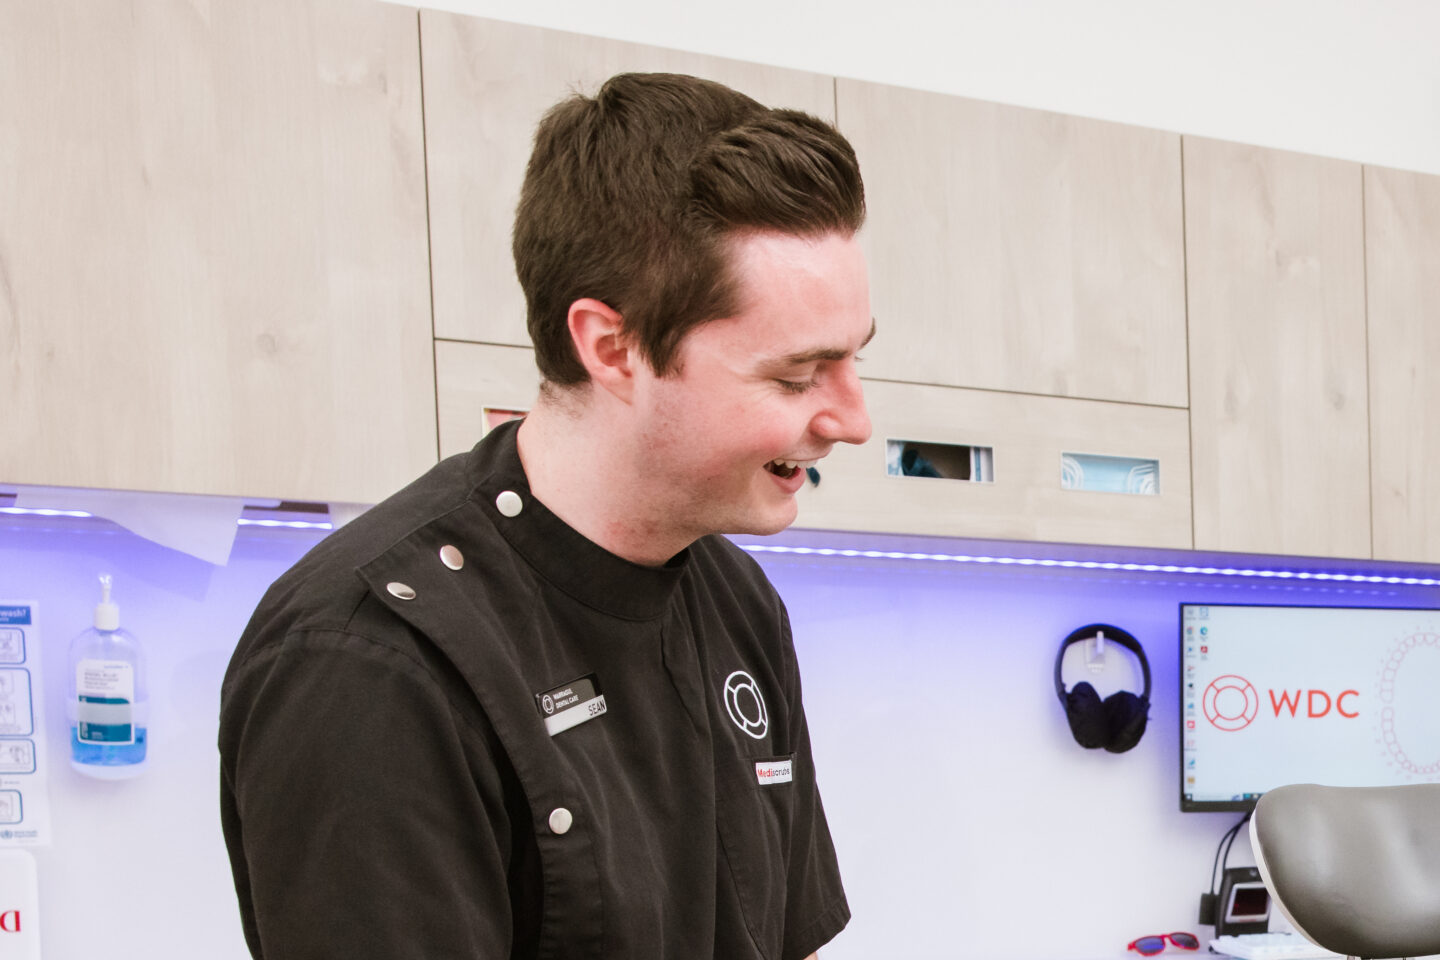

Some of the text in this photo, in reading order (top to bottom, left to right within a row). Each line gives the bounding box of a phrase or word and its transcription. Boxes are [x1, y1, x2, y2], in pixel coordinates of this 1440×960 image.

[588, 699, 605, 716] SEAN
[1268, 689, 1360, 718] WDC
[758, 767, 790, 777] Mediscrubs
